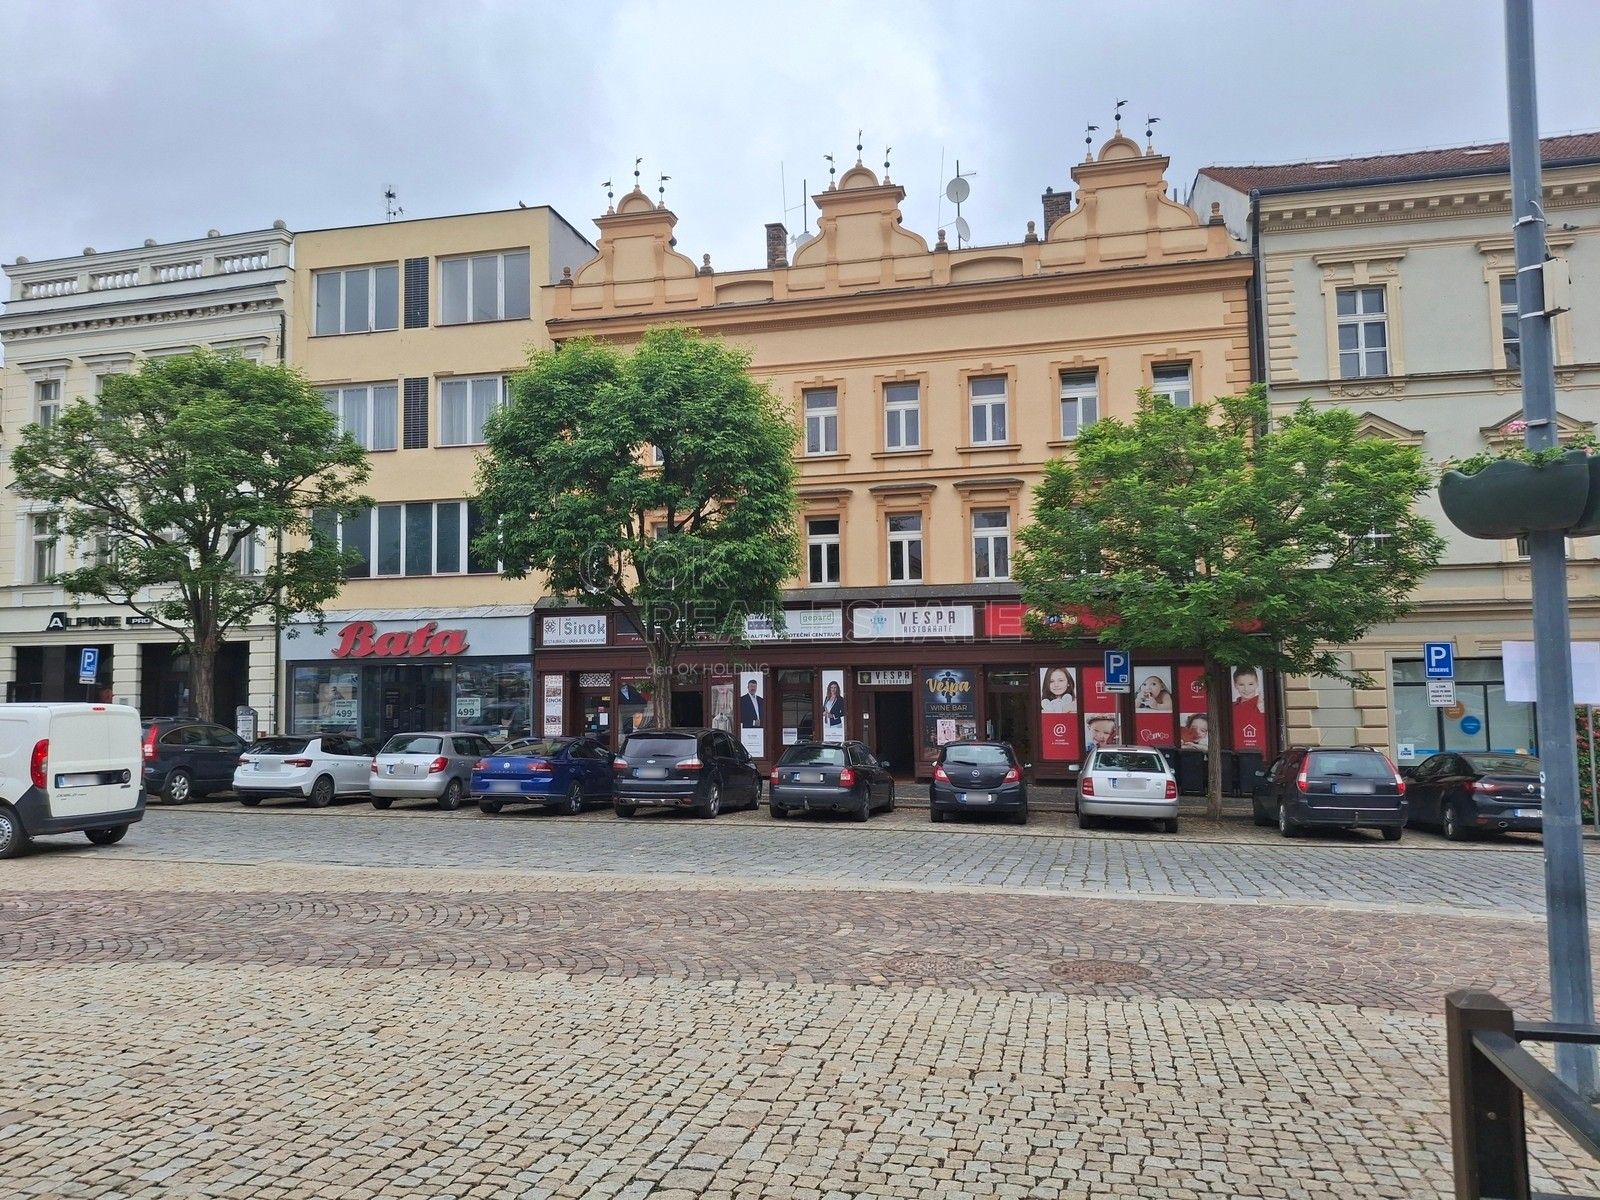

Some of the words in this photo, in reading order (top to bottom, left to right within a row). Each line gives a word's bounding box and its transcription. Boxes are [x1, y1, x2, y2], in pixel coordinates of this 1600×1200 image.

[47, 614, 121, 630] ALPINE
[802, 612, 833, 622] gepard
[899, 610, 956, 625] VESPA
[563, 617, 605, 636] Šinok
[83, 651, 94, 668] P
[1109, 654, 1125, 674] P
[1430, 646, 1447, 667] P
[875, 671, 910, 679] VESPA
[925, 678, 971, 696] Vespa
[336, 709, 352, 717] 499
[458, 708, 475, 716] 499
